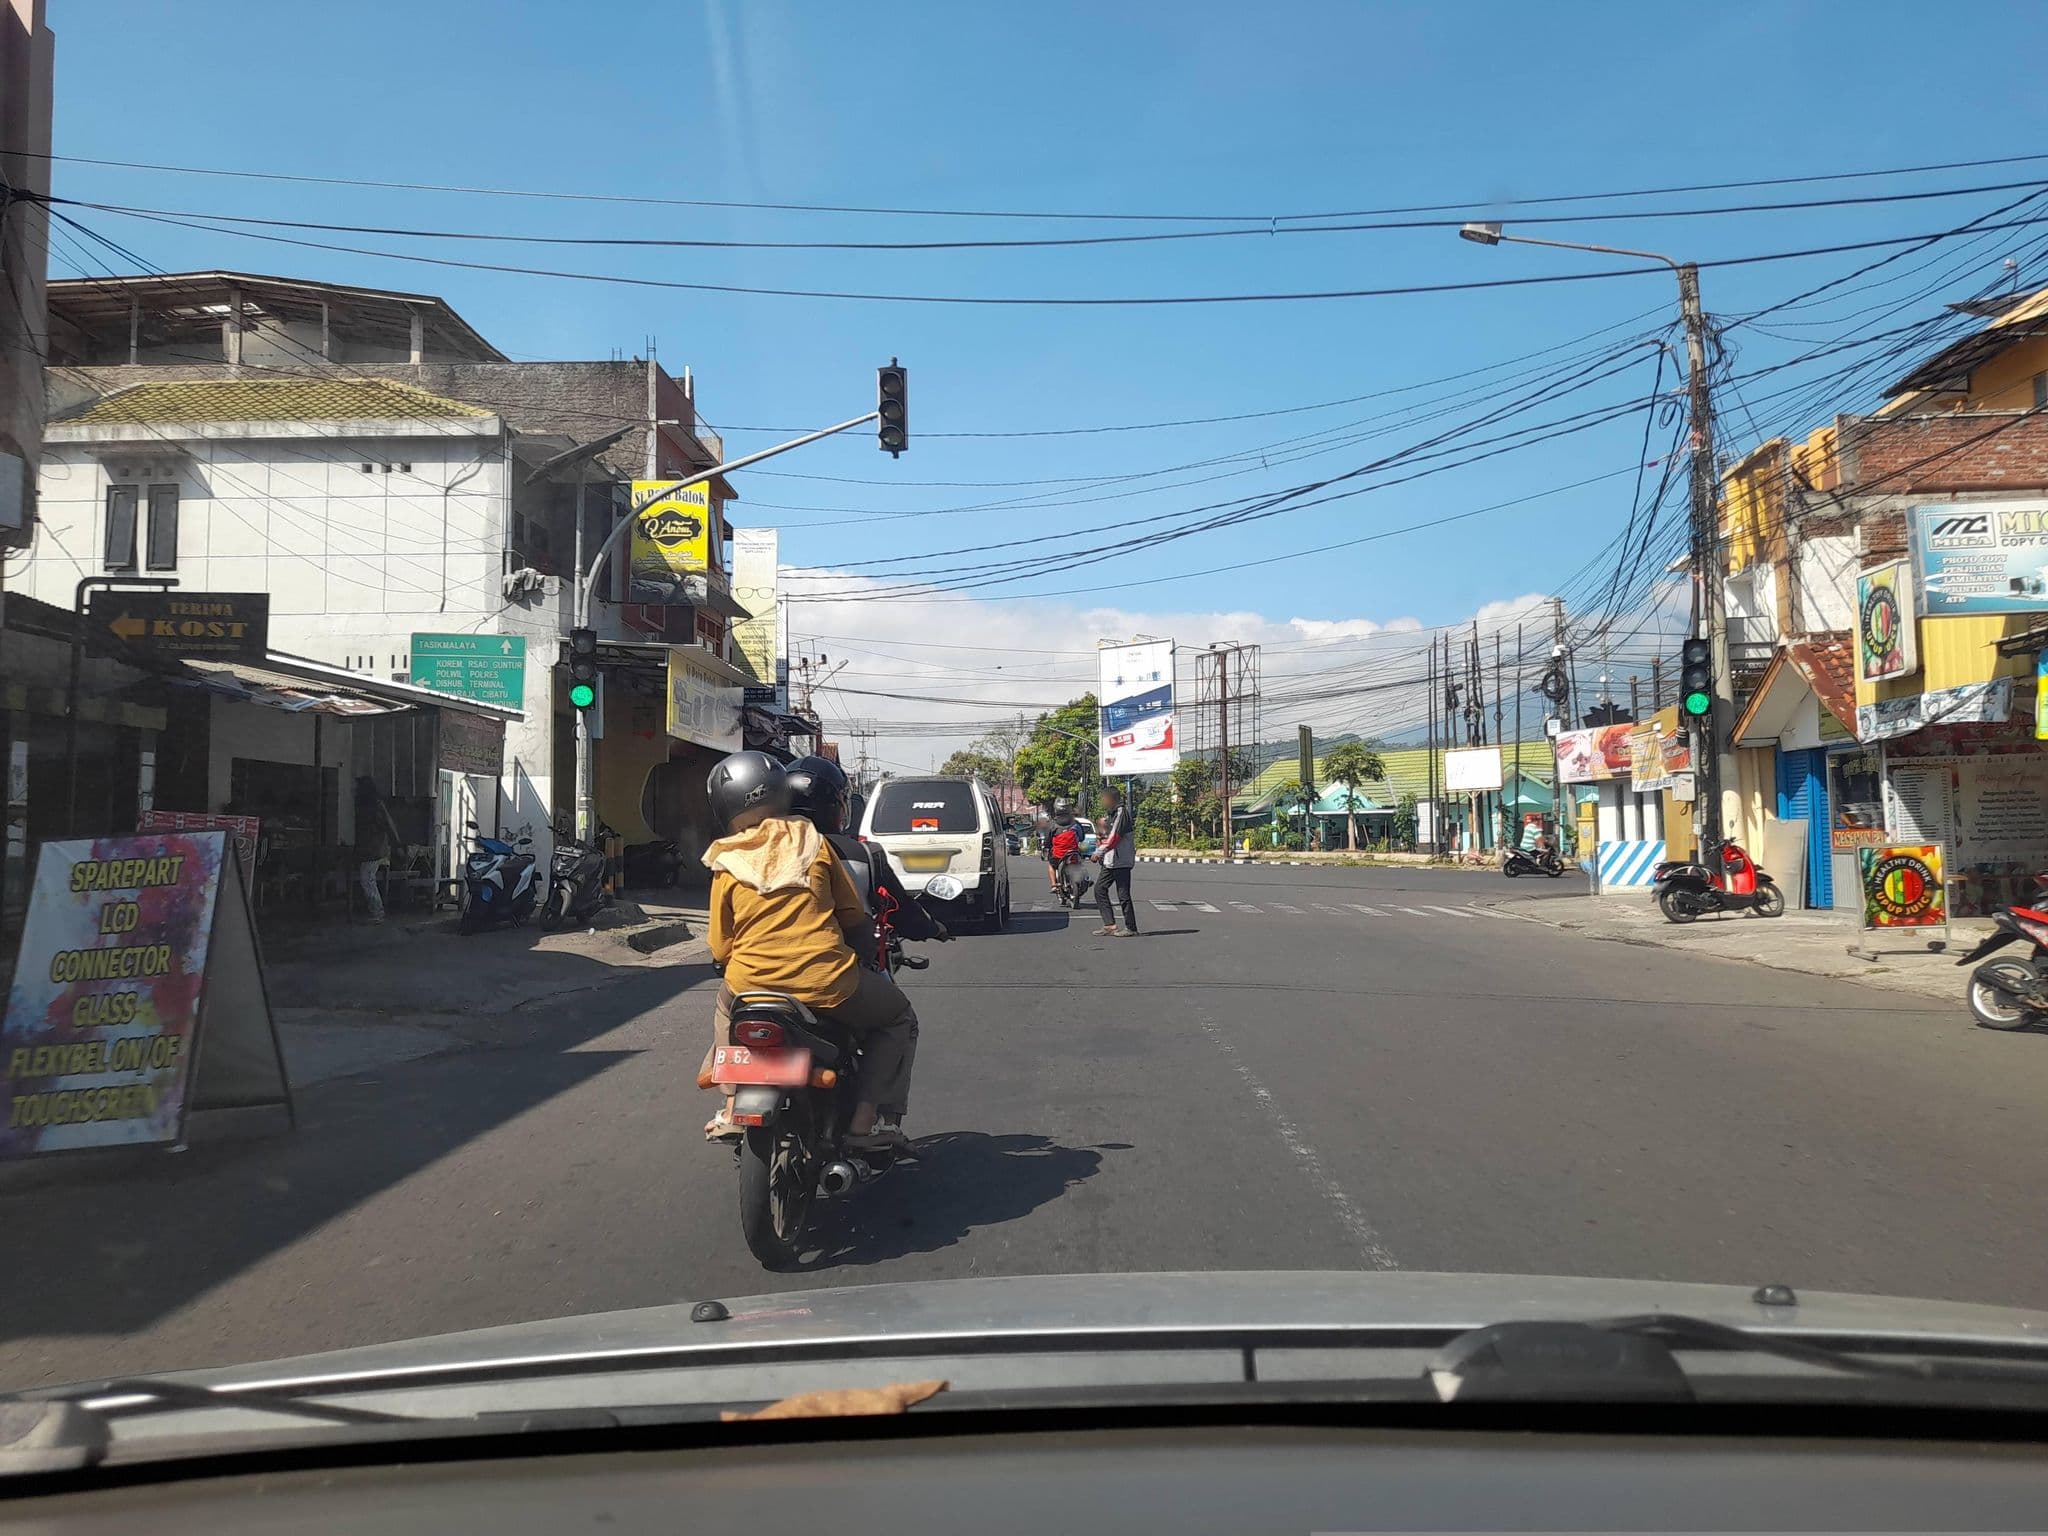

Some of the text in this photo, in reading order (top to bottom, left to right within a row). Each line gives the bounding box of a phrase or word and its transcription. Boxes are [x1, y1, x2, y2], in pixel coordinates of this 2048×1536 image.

[2001, 537, 2034, 548] COPY
[153, 620, 248, 638] KOST
[419, 640, 477, 650] TASIKMALAYA
[470, 671, 499, 679] POLRES
[470, 680, 505, 689] TERMINAL
[482, 690, 509, 699] CIBATU
[71, 856, 184, 892] SPAREPART
[1874, 858, 1933, 884] HEALTHY DRINK
[100, 901, 140, 935] LCD
[52, 945, 172, 983] CONNECTOR
[73, 992, 138, 1029] GLASS
[716, 1050, 752, 1064] B 62
